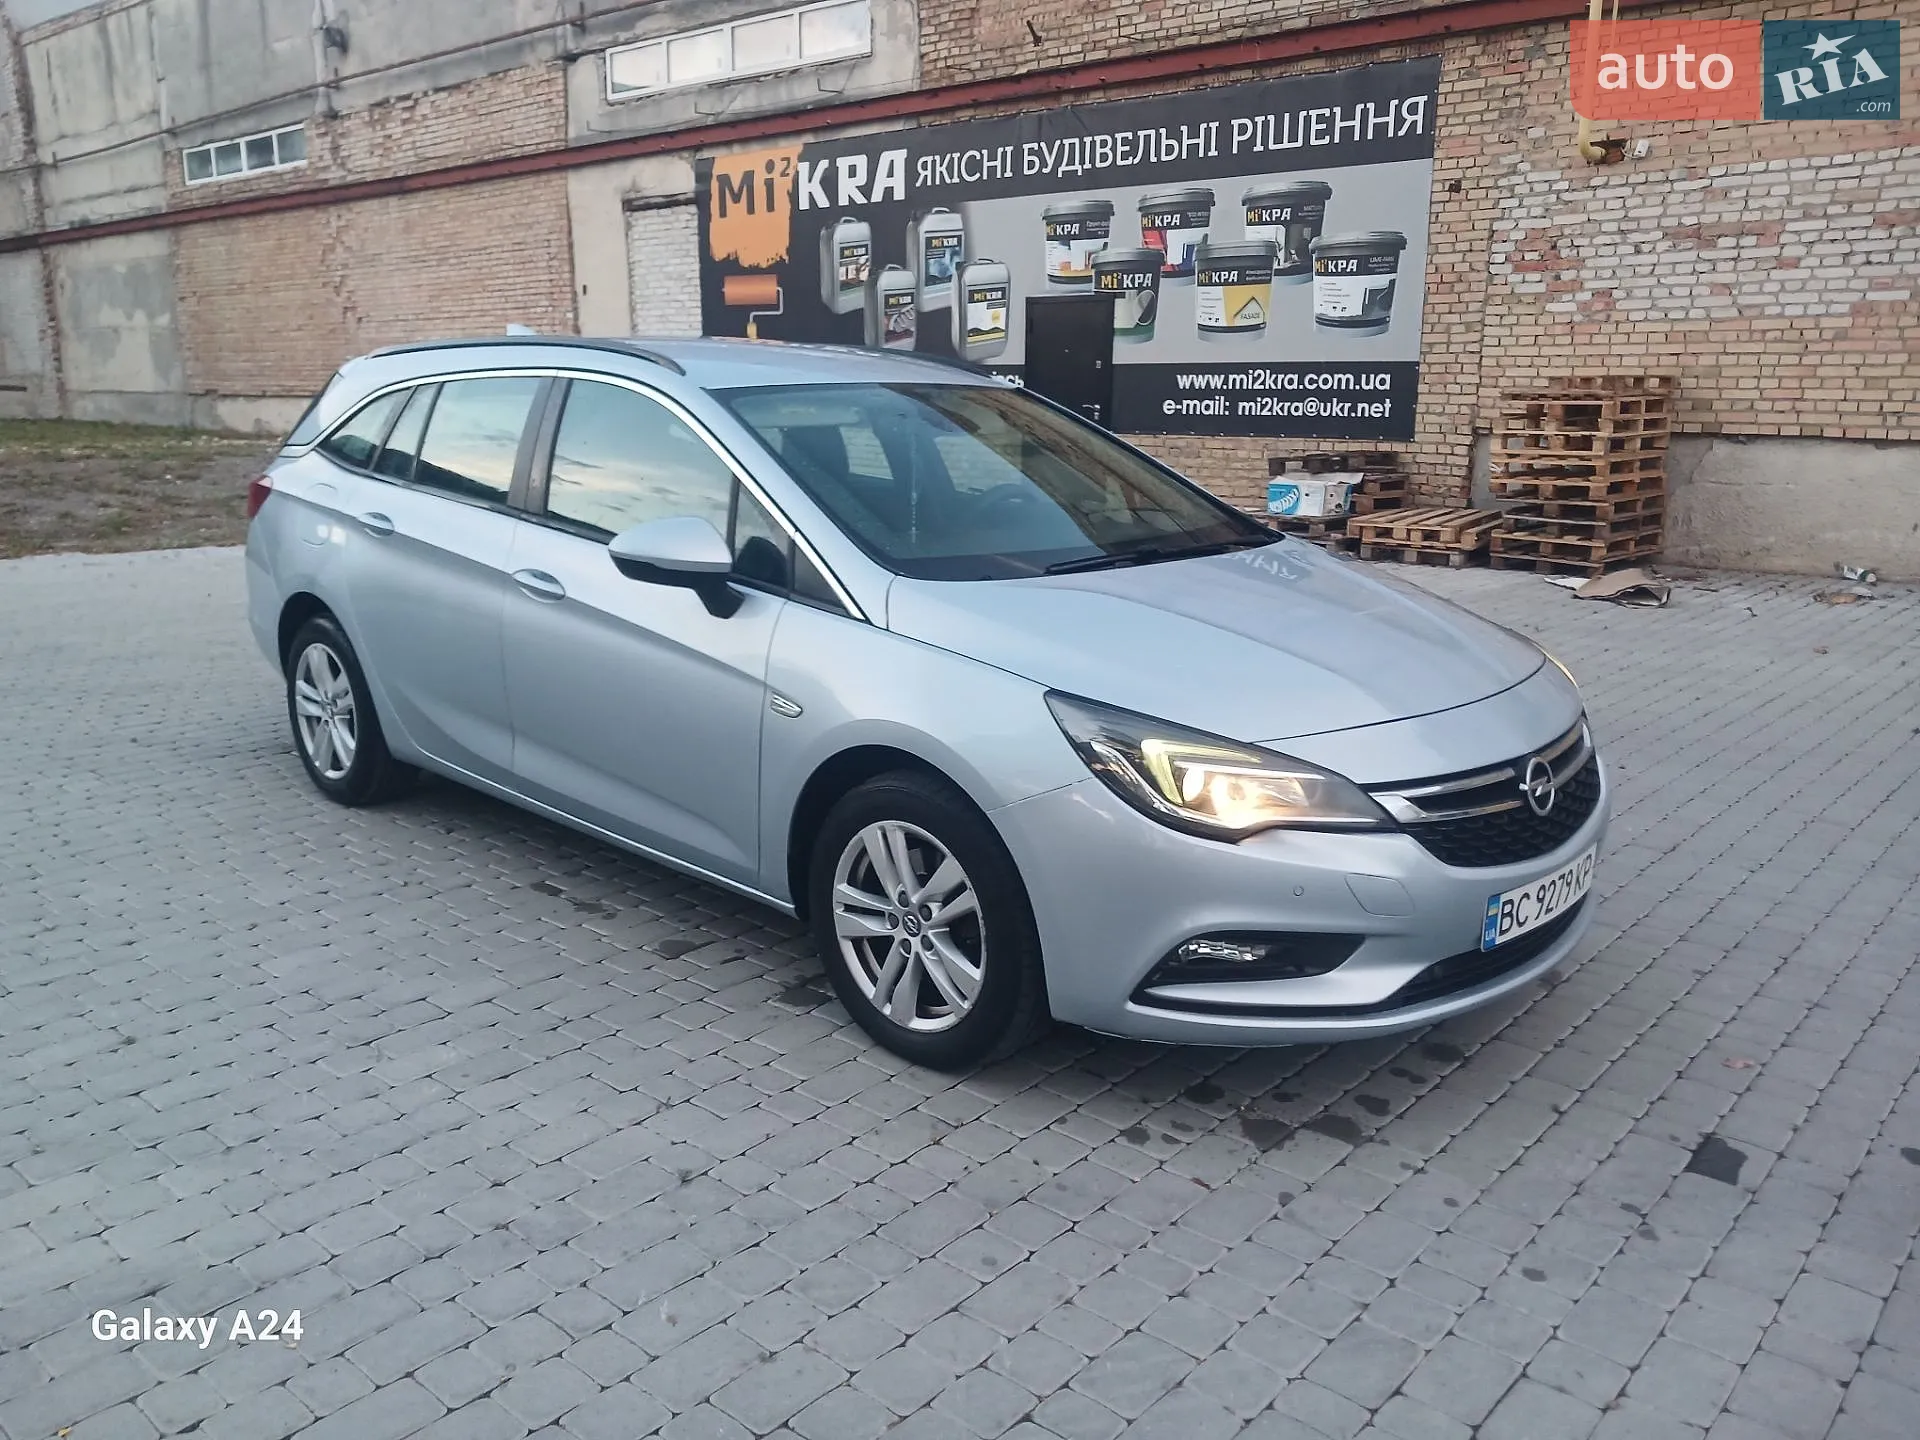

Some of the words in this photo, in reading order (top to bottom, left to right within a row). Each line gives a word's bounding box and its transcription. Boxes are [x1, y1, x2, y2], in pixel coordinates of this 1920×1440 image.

[916, 145, 1013, 187] ЯКІСНІ
[1022, 121, 1220, 177] БУДІВЕЛЬНІ
[1230, 95, 1429, 154] РІШЕННЯ
[1176, 369, 1392, 391] www.mi2kra.com.ua
[1162, 396, 1230, 416] e-mail:
[1237, 397, 1392, 418] mi2kra@ukr.net
[1498, 891, 1531, 937] BC
[1535, 869, 1574, 921] 9279
[1573, 853, 1592, 896] KP
